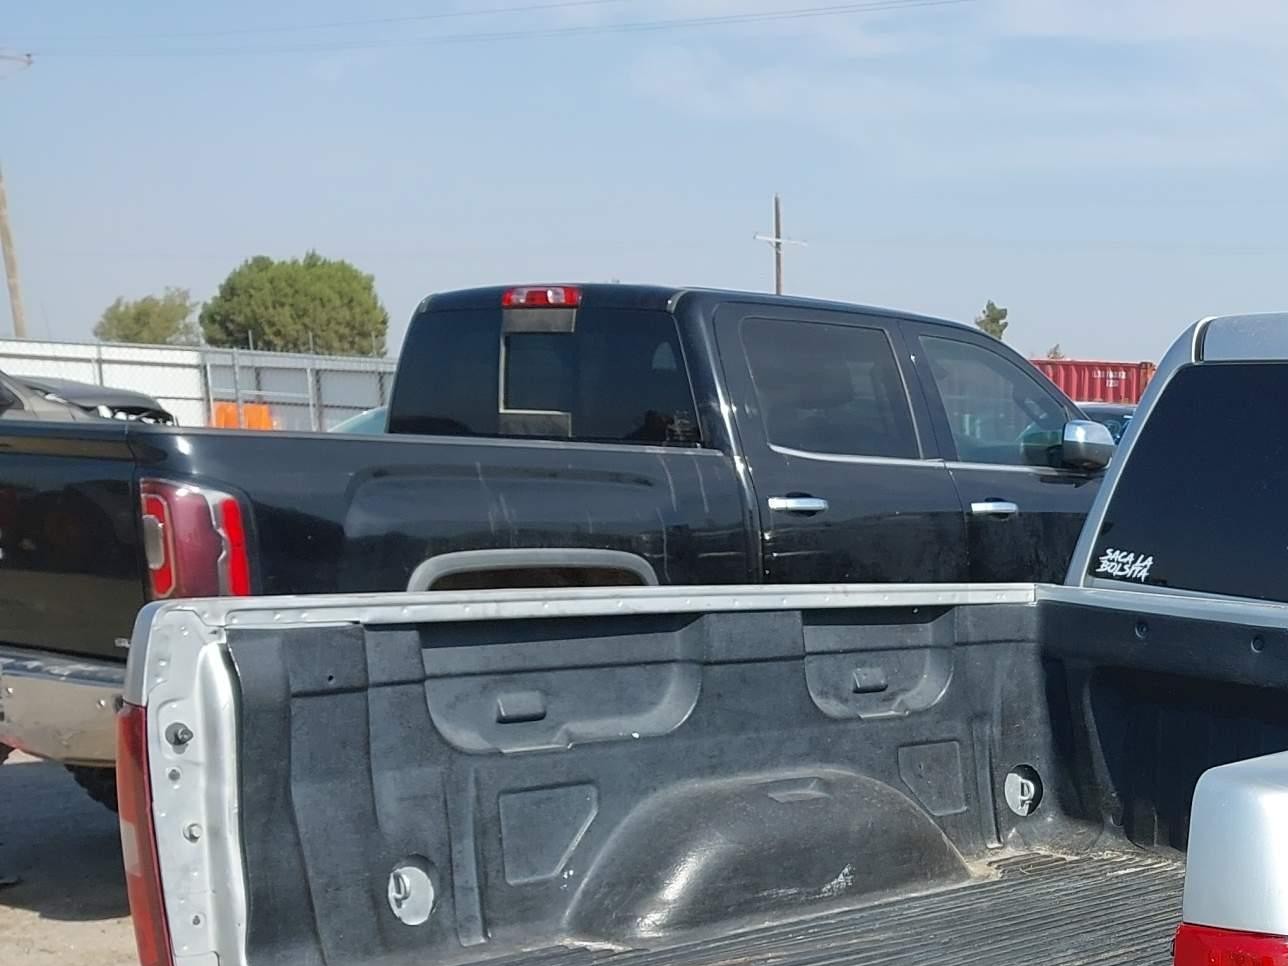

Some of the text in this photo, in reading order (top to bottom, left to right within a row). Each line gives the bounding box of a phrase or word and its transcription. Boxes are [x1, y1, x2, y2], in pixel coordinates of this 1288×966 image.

[1099, 548, 1154, 569] SACA LA
[1096, 560, 1150, 583] BOLSITA
